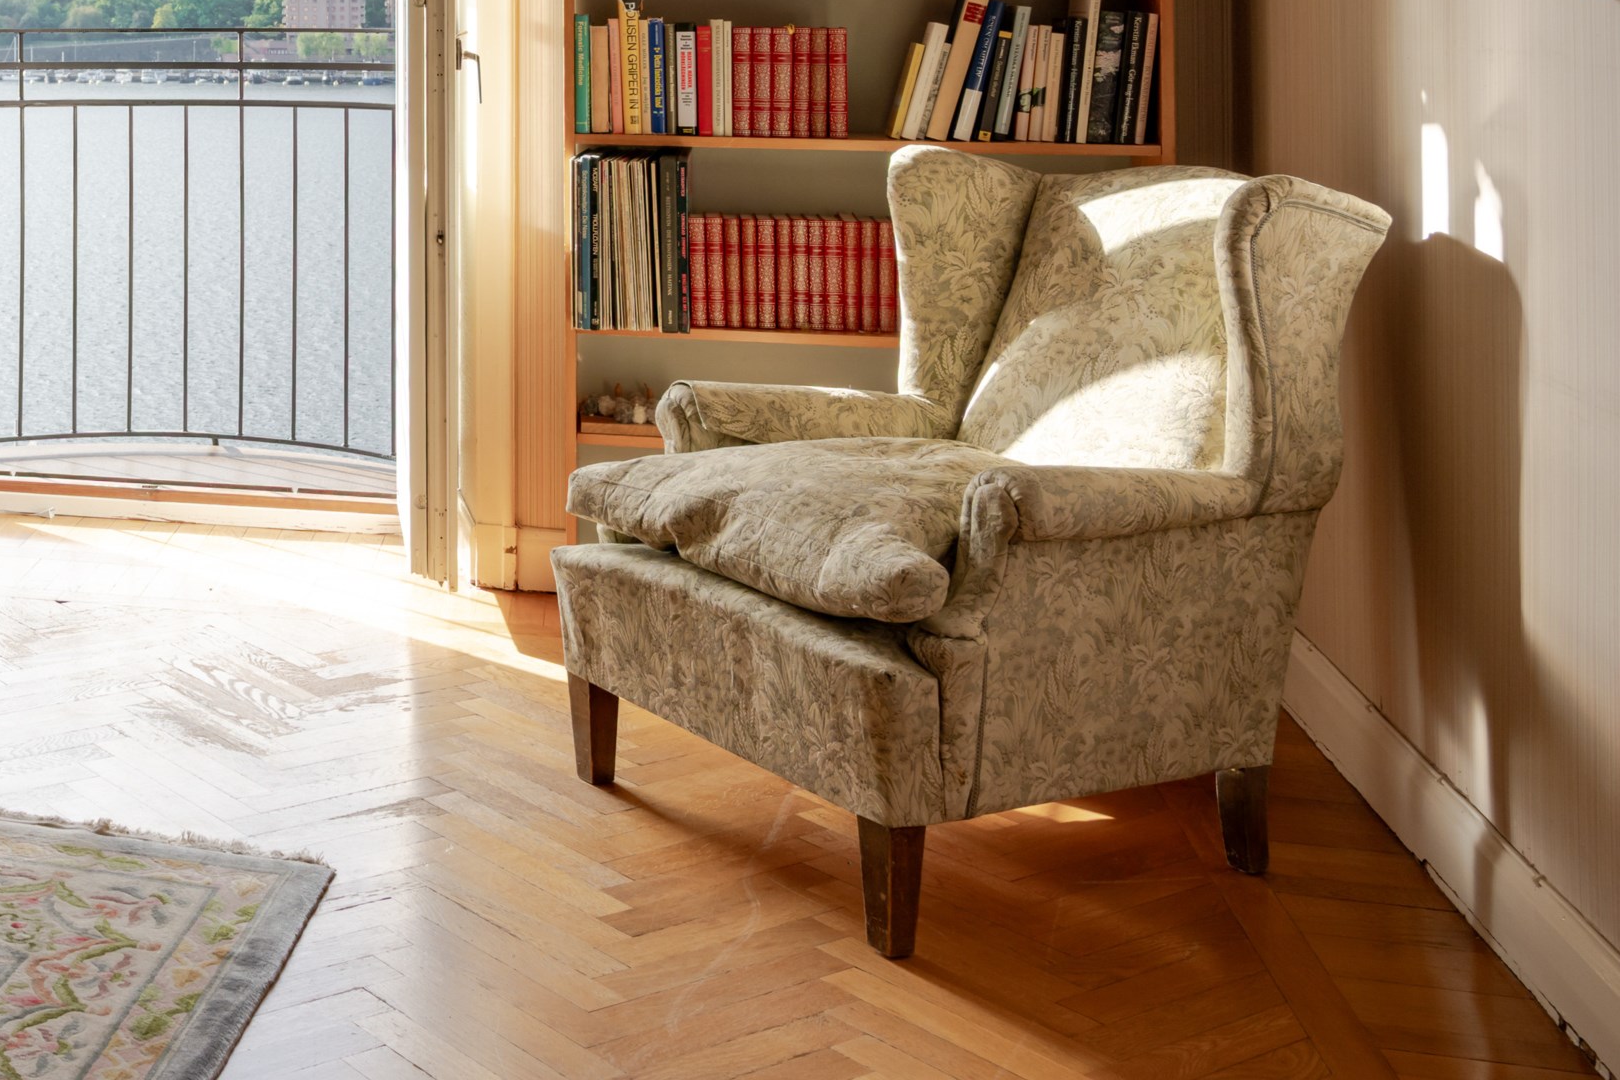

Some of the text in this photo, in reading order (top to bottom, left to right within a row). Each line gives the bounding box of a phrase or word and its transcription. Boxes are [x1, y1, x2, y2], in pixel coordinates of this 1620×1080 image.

[625, 1, 638, 51] POLISEN
[1132, 17, 1142, 41] Kerstin
[1130, 42, 1140, 65] Ekman
[628, 53, 638, 96] GRIPER
